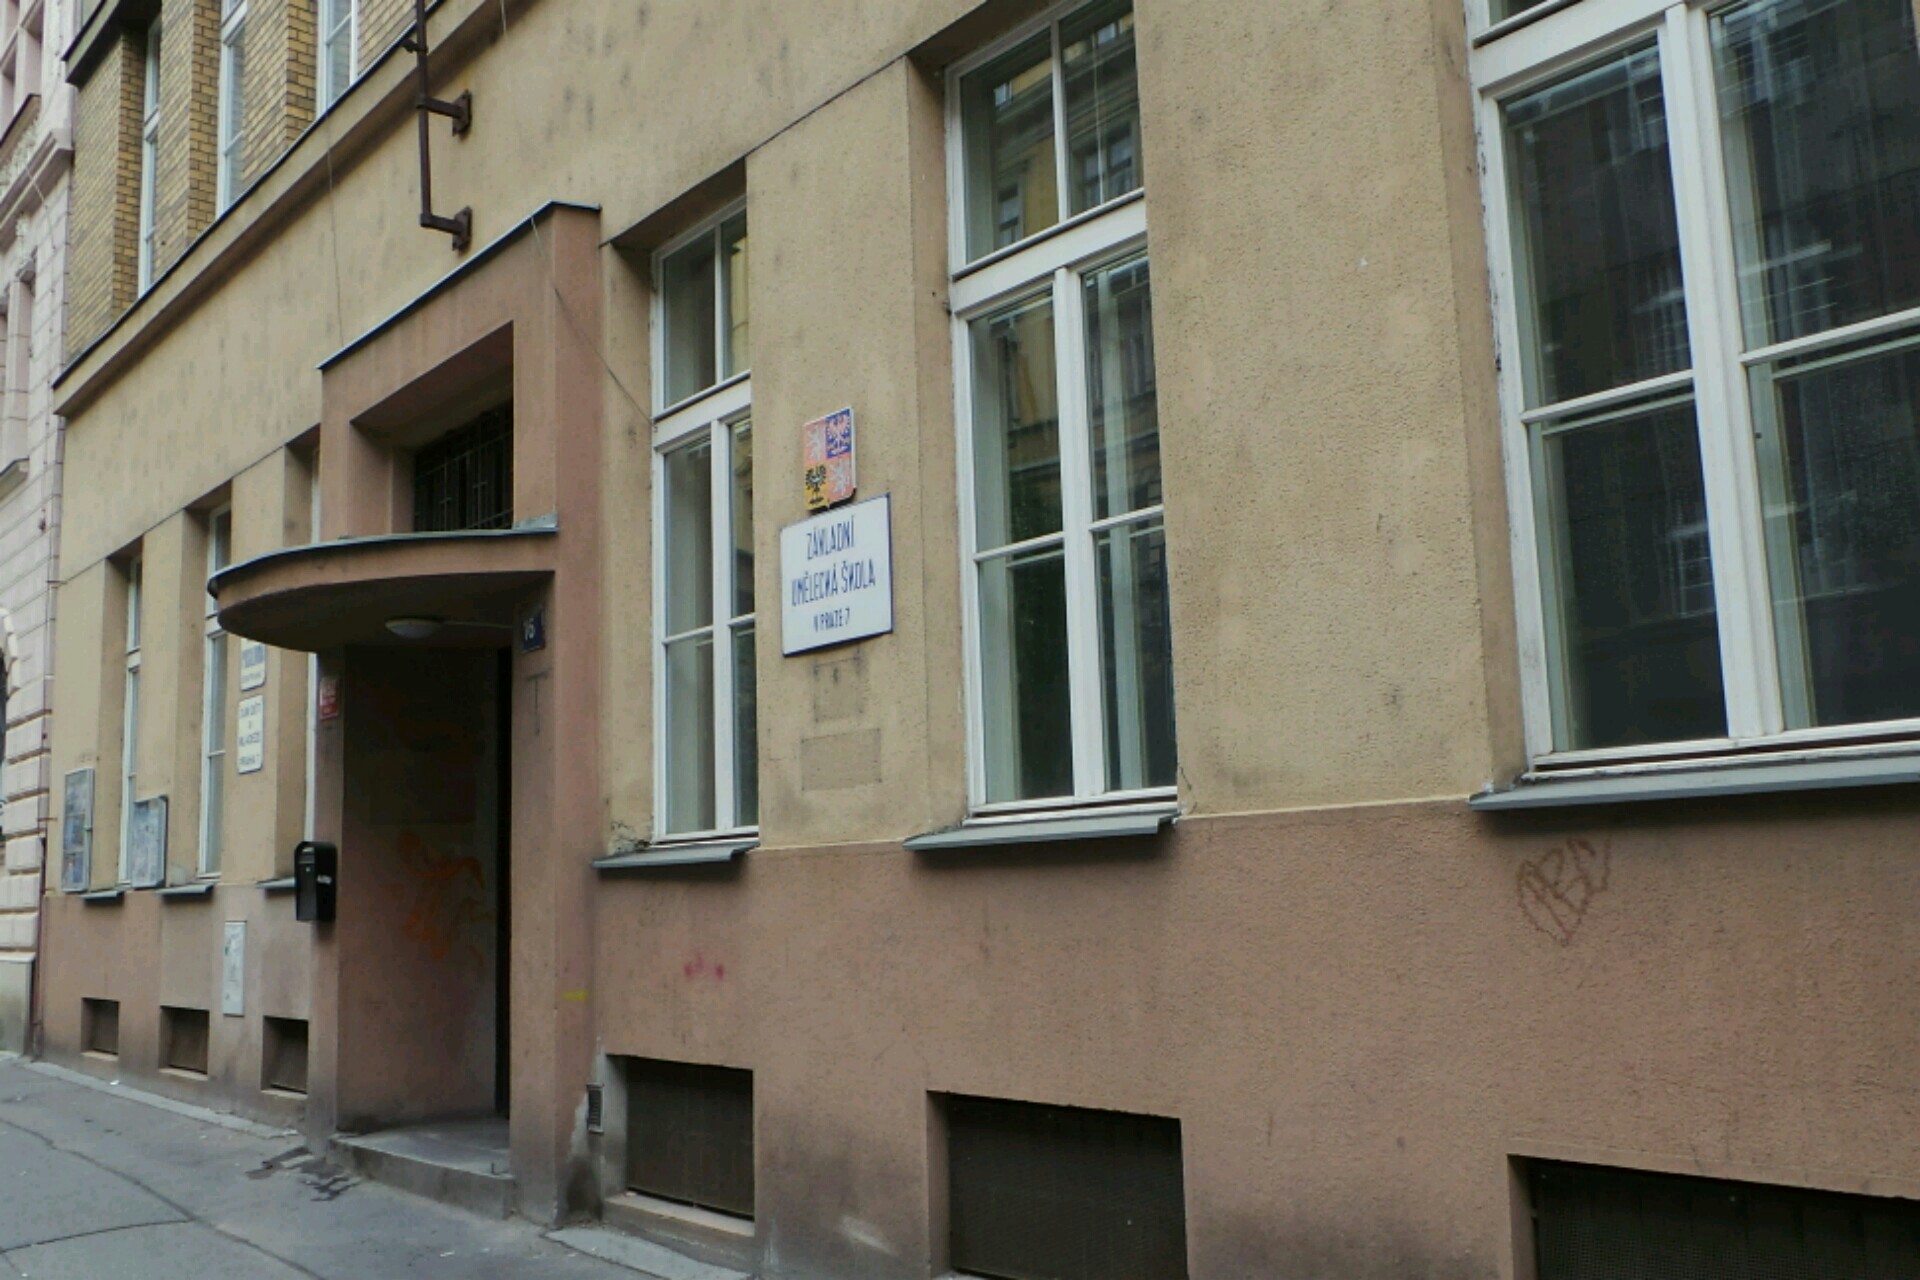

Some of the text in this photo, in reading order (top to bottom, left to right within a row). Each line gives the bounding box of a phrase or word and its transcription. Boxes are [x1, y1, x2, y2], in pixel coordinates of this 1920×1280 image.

[806, 514, 856, 560] ZÁKLADNÍ
[791, 558, 876, 607] UMĚLECKÁ ŠKOLA
[845, 607, 850, 625] 7
